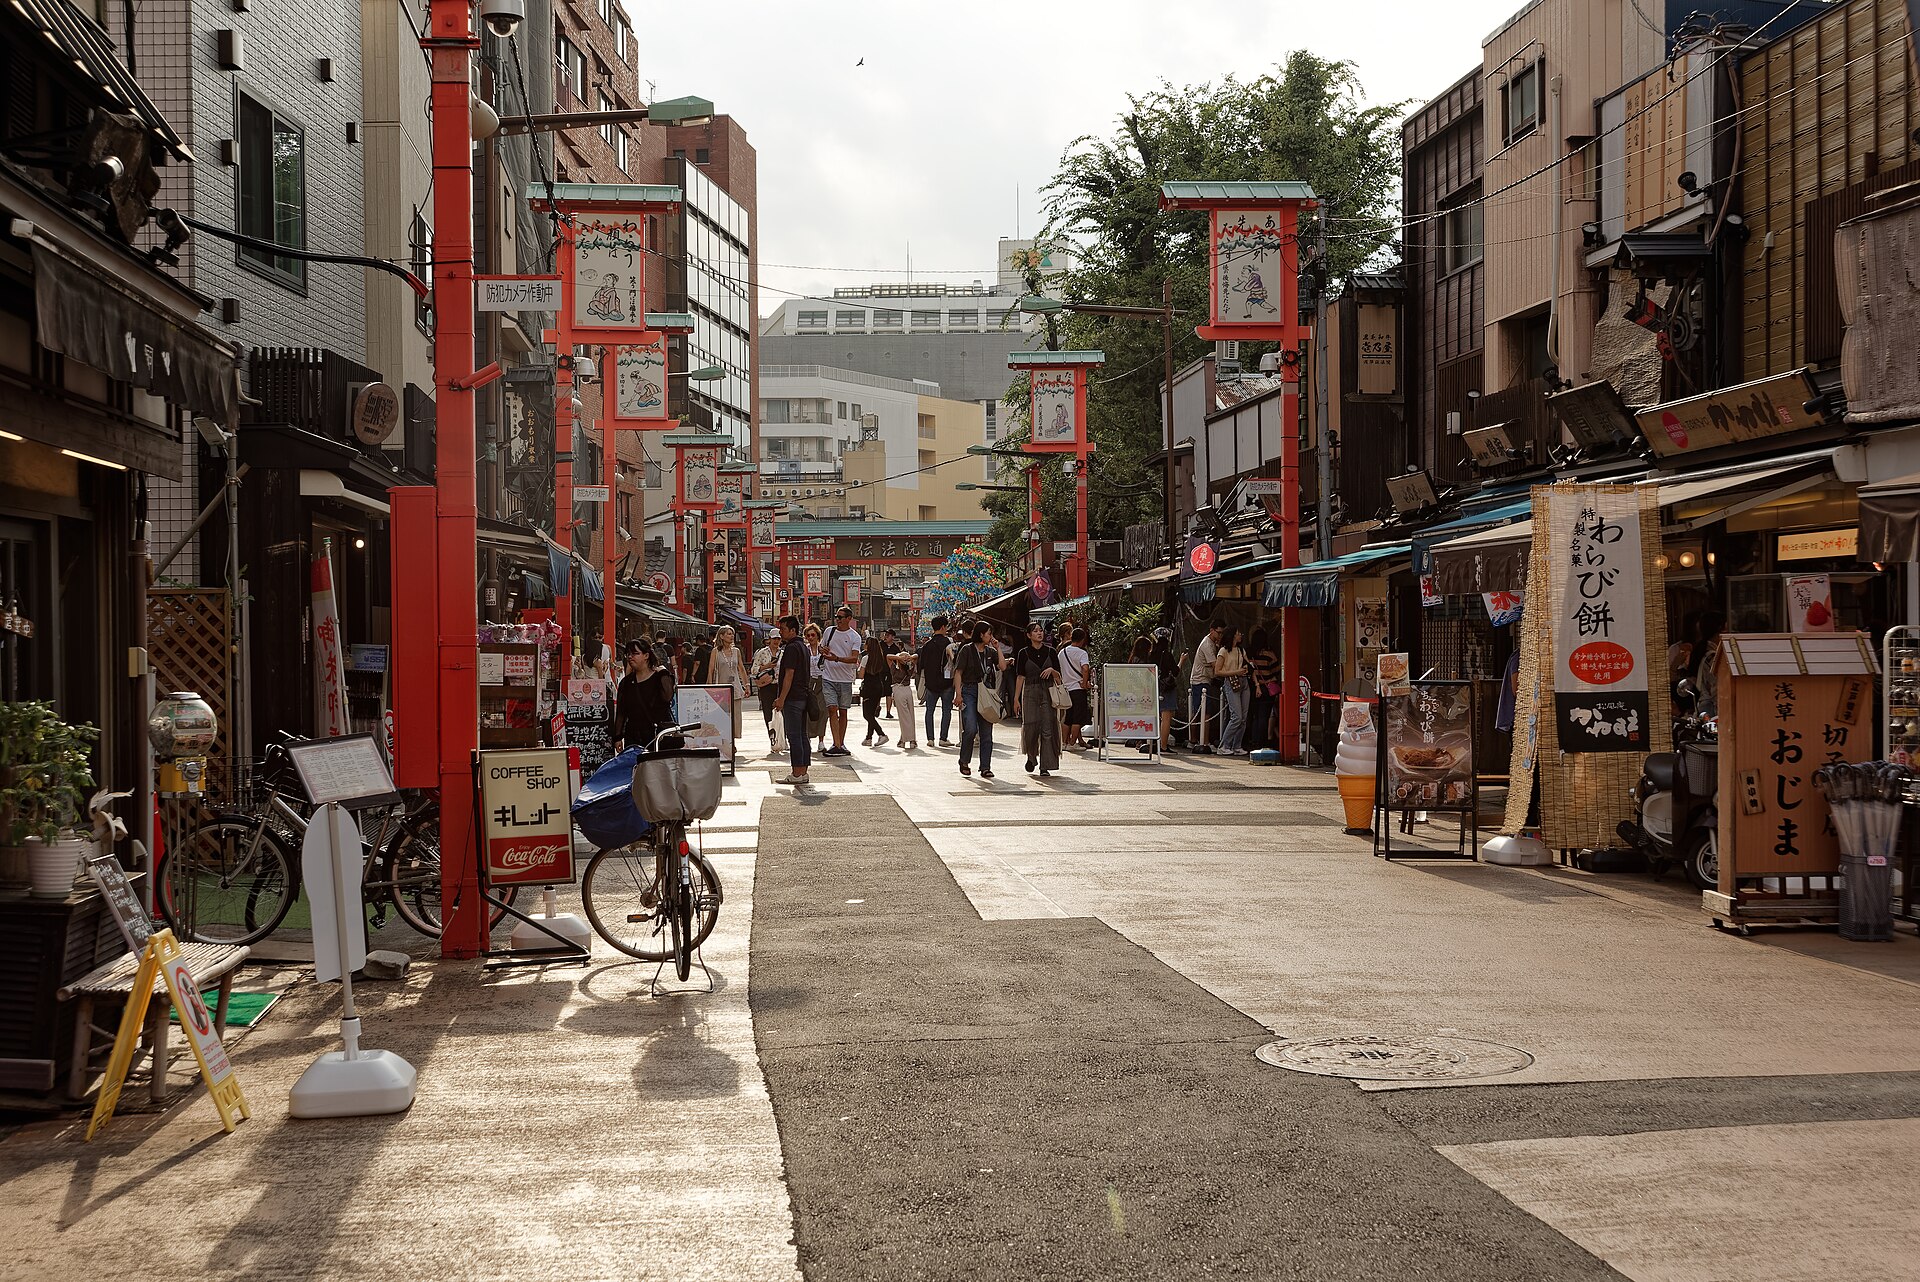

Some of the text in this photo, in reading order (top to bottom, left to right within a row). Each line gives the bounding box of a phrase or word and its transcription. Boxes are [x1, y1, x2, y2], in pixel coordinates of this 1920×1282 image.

[486, 283, 554, 303] 防犯カメラ作動中
[1569, 507, 1596, 567] 特製名菓
[713, 528, 727, 574] 大黒家
[857, 540, 945, 557] 伝法院通
[1571, 516, 1624, 637] わらび餅
[1593, 672, 1611, 681] 使用
[567, 704, 605, 719] 無限堂
[1419, 700, 1436, 744] わらび餅
[490, 765, 544, 779] COFFEE
[526, 776, 561, 789] SHOP
[1770, 729, 1803, 856] おじま
[493, 802, 561, 827] キレット
